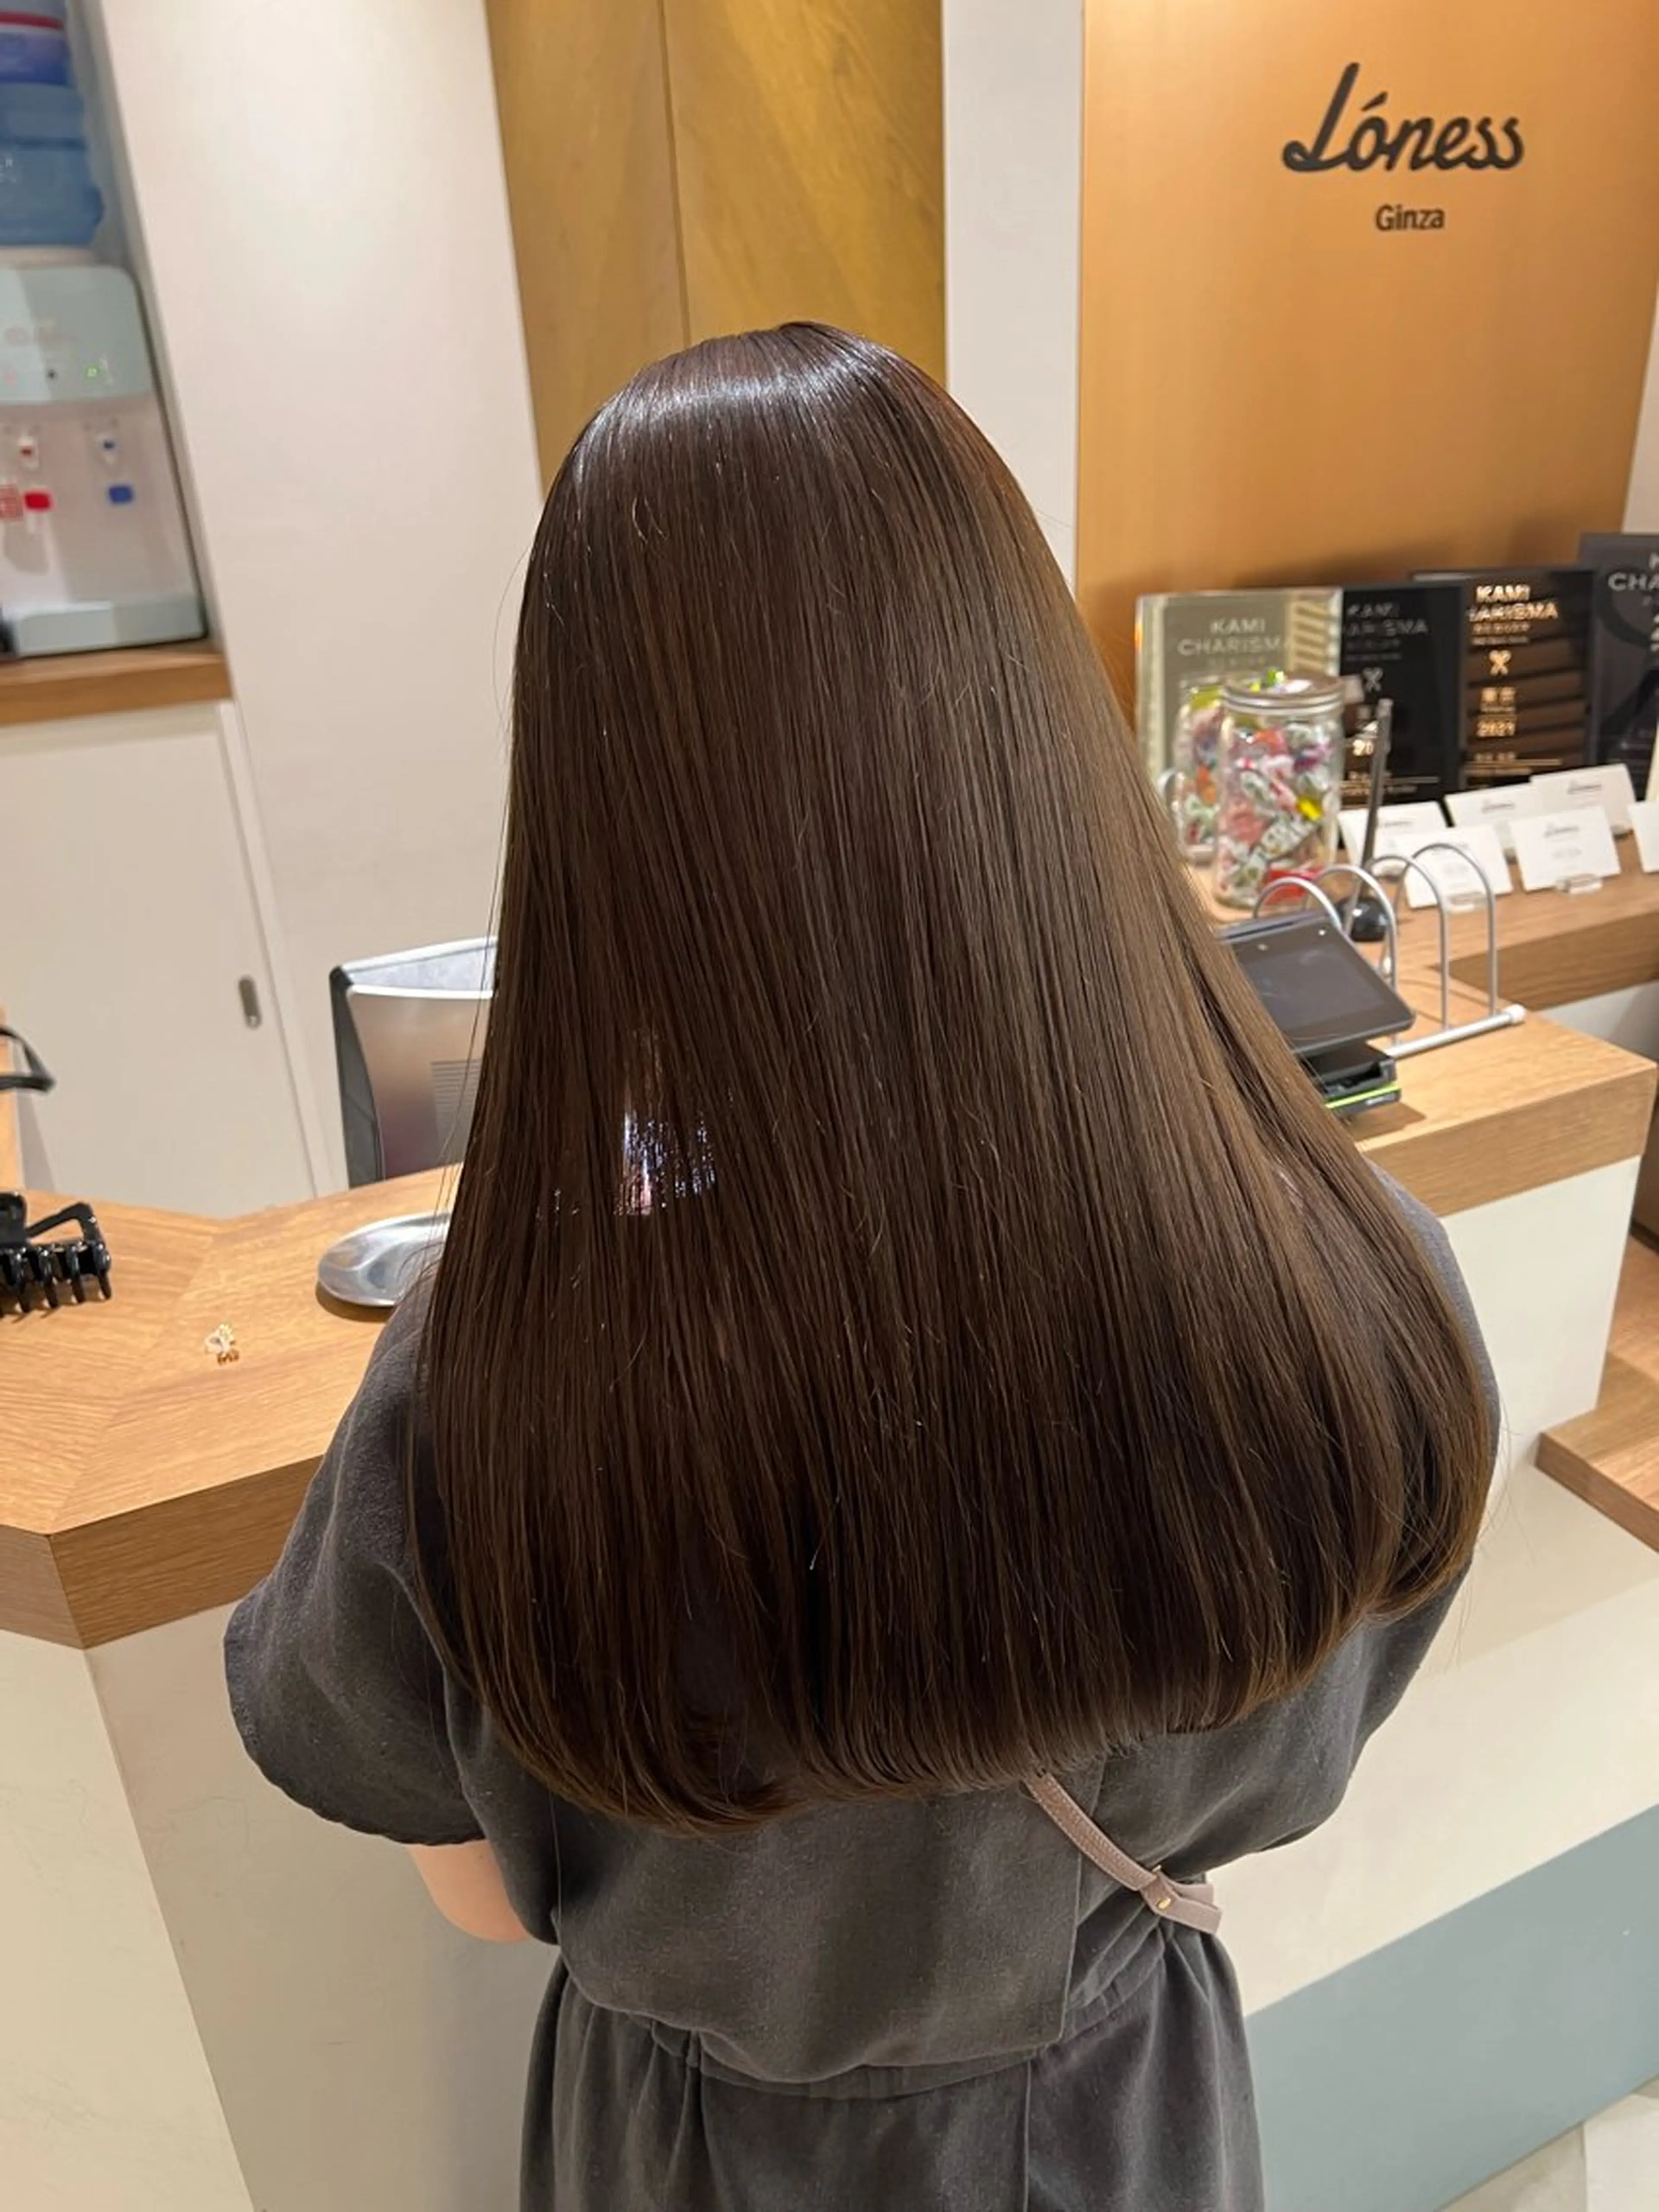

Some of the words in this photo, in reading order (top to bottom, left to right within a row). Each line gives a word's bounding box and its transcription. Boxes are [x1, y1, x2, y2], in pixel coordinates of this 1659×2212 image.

[1375, 204, 1445, 231] Ginza
[1476, 585, 1531, 604] KAMI
[1211, 618, 1266, 634] KAMI
